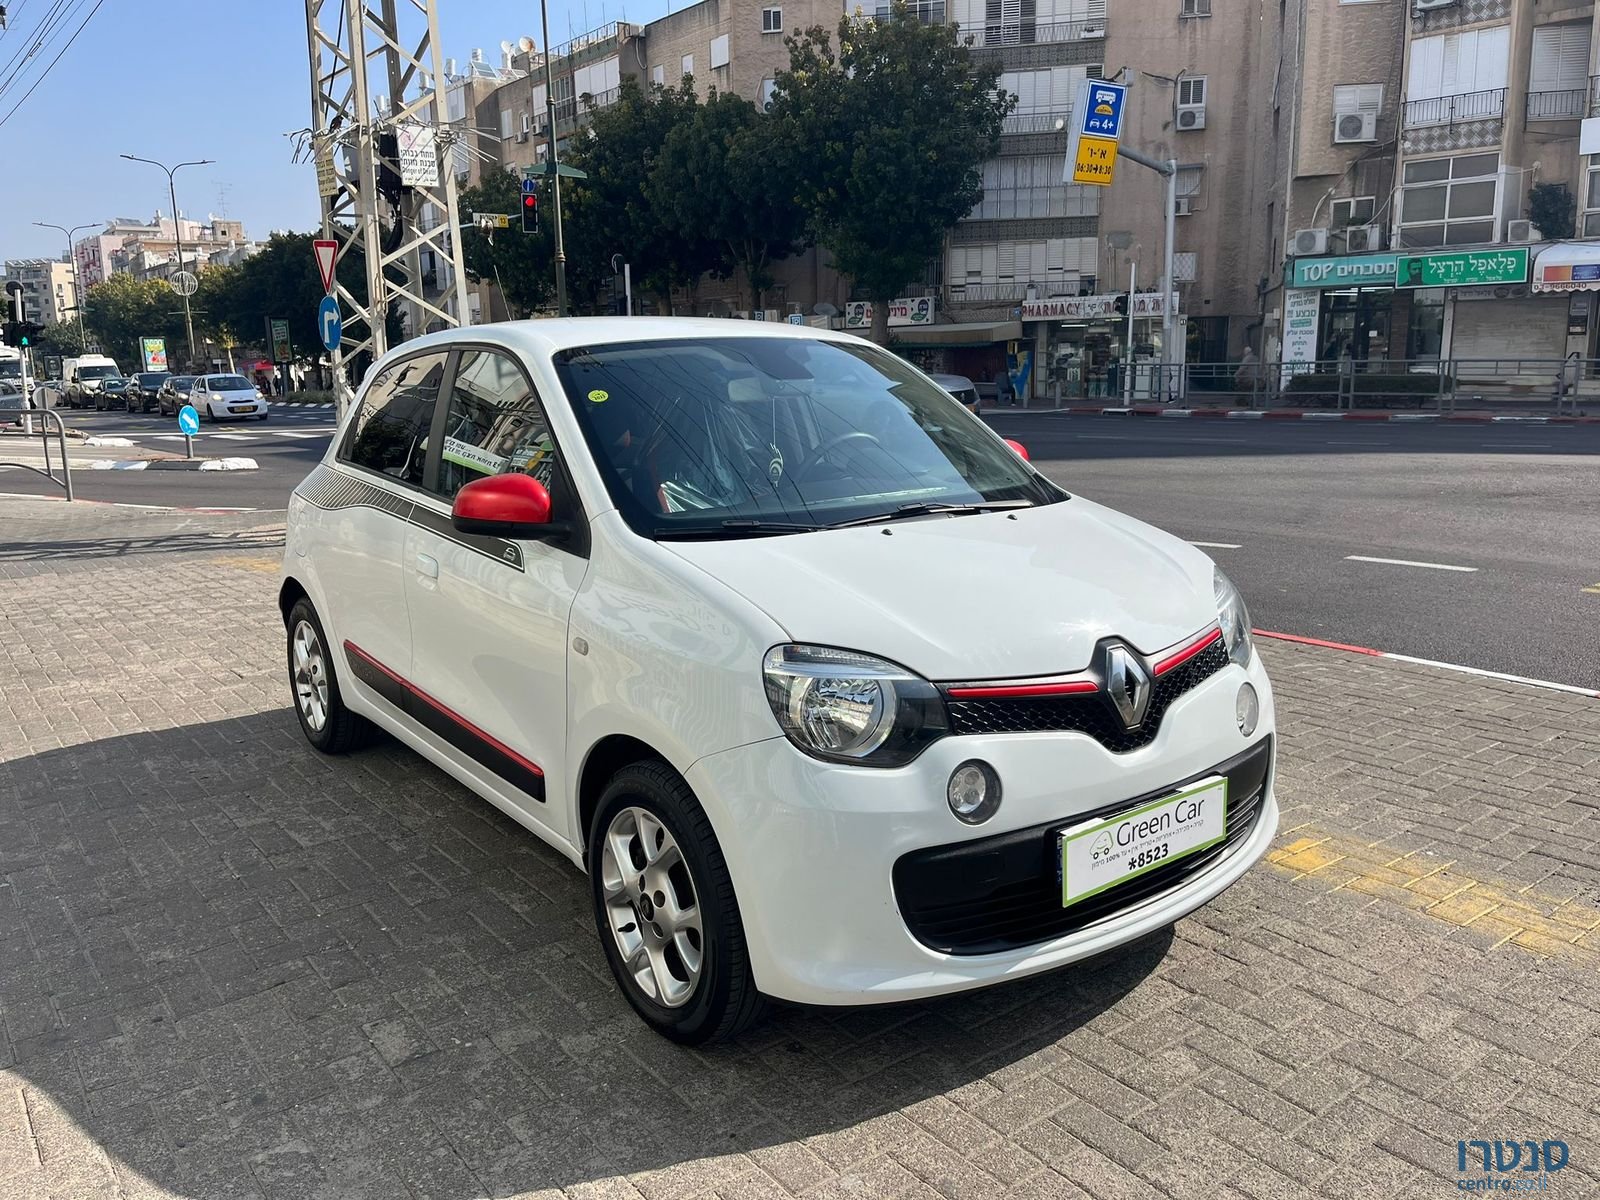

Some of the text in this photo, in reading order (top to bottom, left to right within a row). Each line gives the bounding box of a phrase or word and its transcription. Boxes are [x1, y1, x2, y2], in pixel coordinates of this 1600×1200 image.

[1101, 118, 1114, 130] 4+
[1300, 262, 1335, 282] TOP
[1022, 302, 1081, 317] PHARMACY
[1295, 309, 1317, 318] מבצע
[1116, 799, 1205, 847] Green Car
[1105, 852, 1120, 864] 100%
